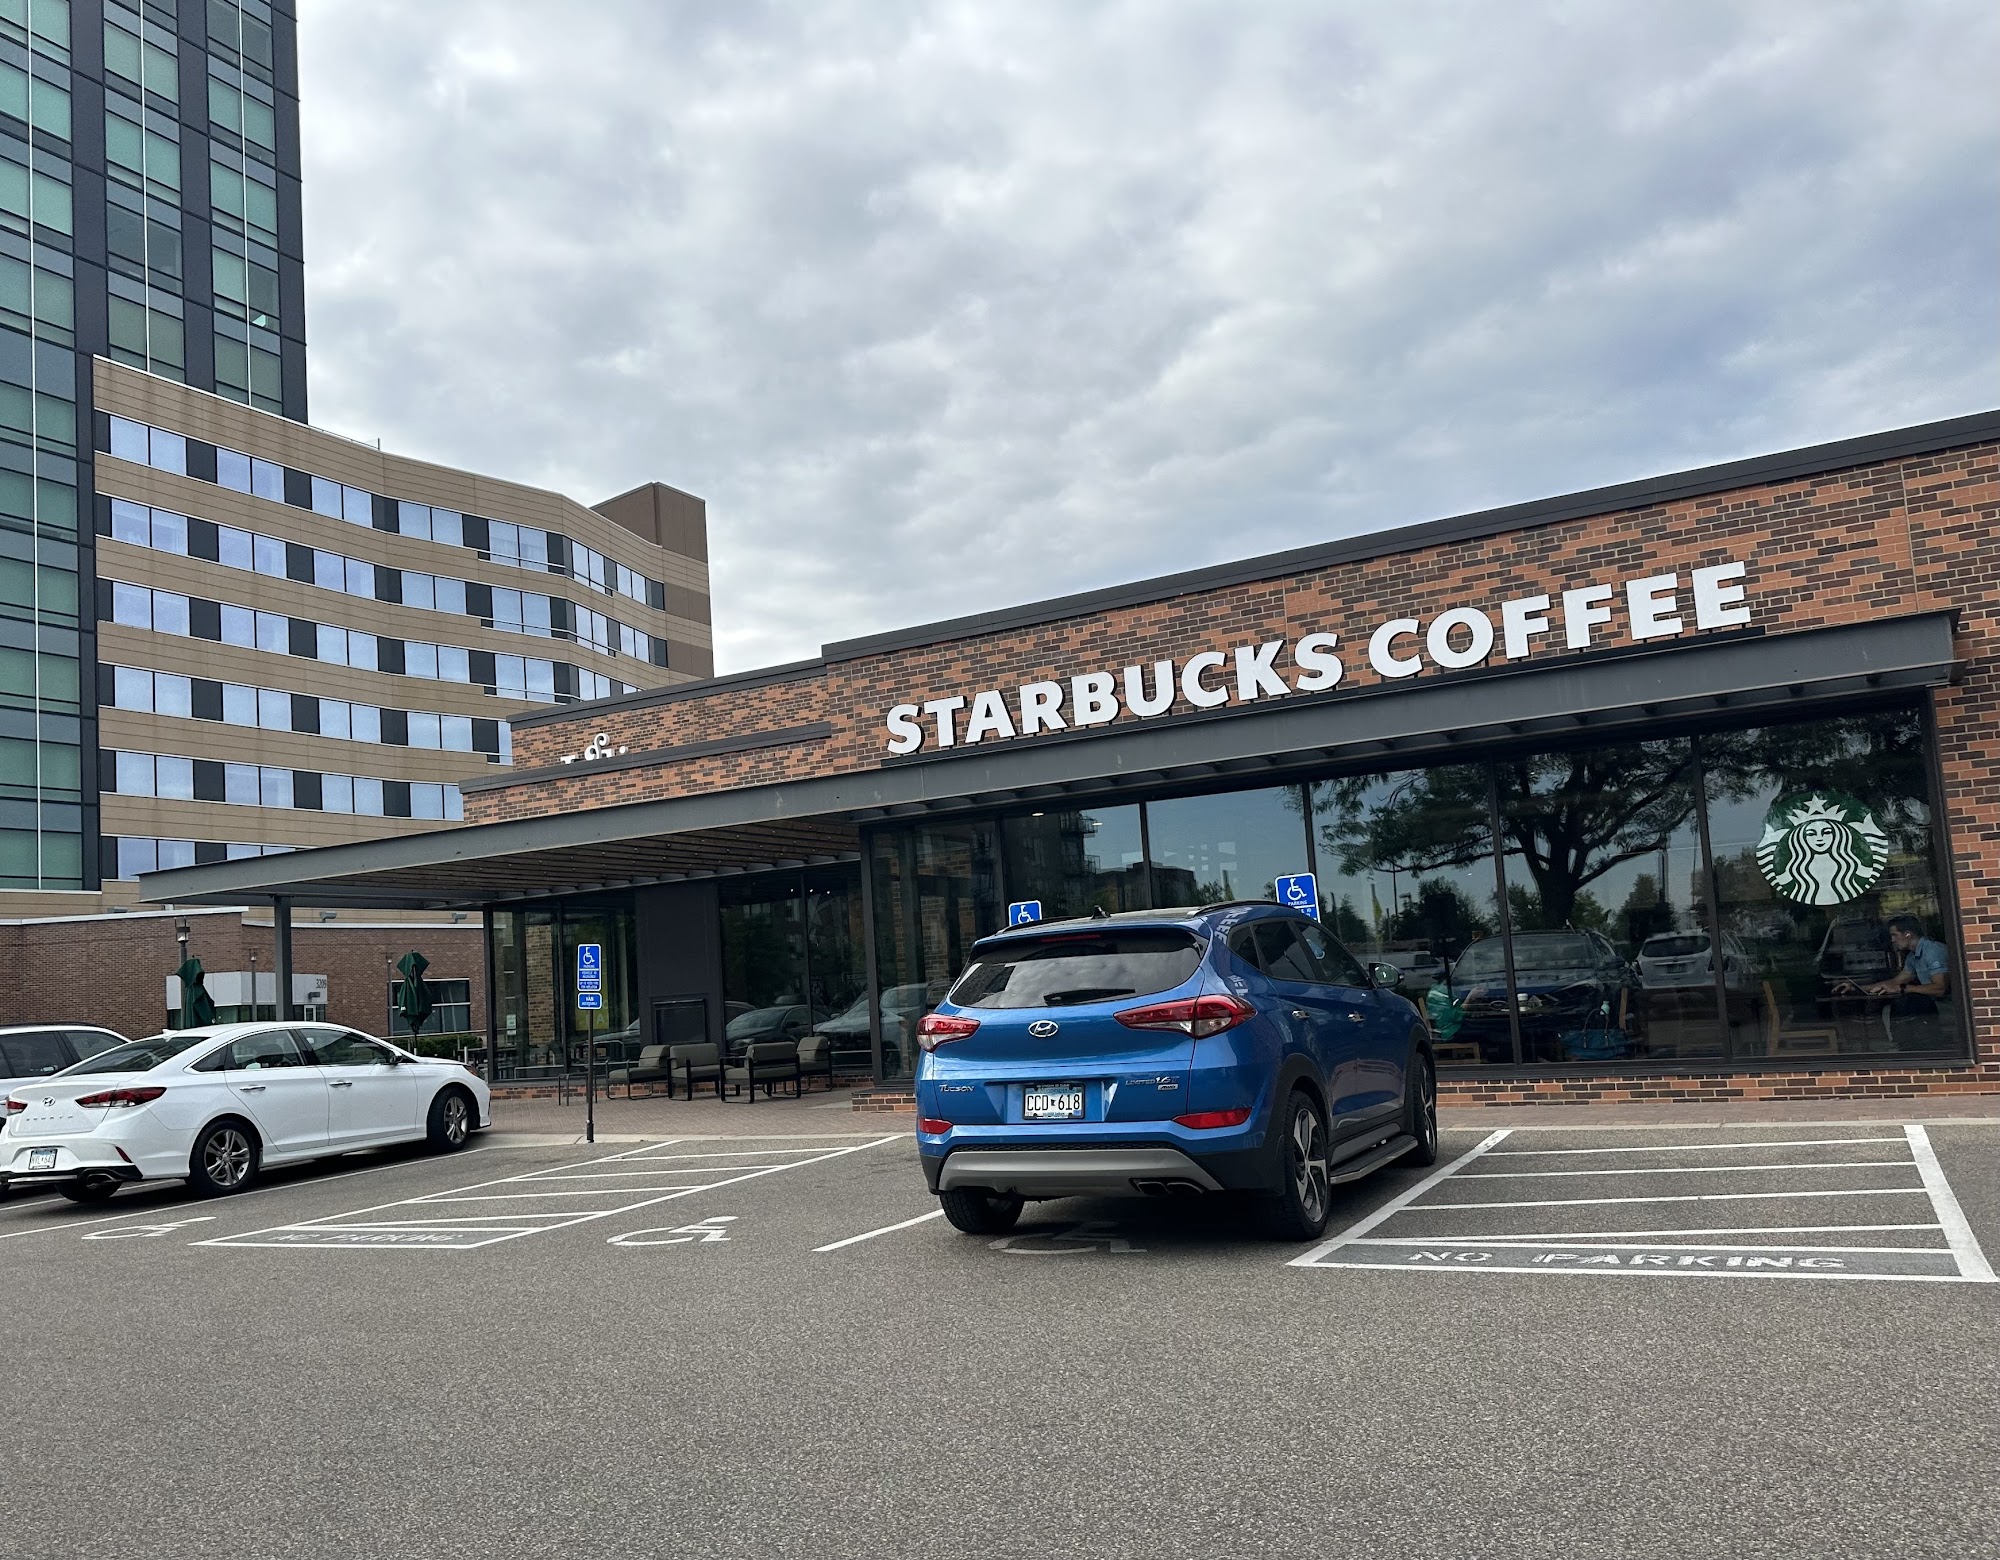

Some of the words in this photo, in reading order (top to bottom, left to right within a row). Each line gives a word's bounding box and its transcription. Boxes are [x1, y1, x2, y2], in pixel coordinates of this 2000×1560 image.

[886, 632, 1344, 754] STARBUCKS
[1368, 561, 1751, 679] COFFEE
[1027, 1095, 1049, 1111] CCD
[1058, 1094, 1080, 1111] 618
[1408, 1251, 1493, 1262] NO
[1531, 1253, 1848, 1269] PARKING
